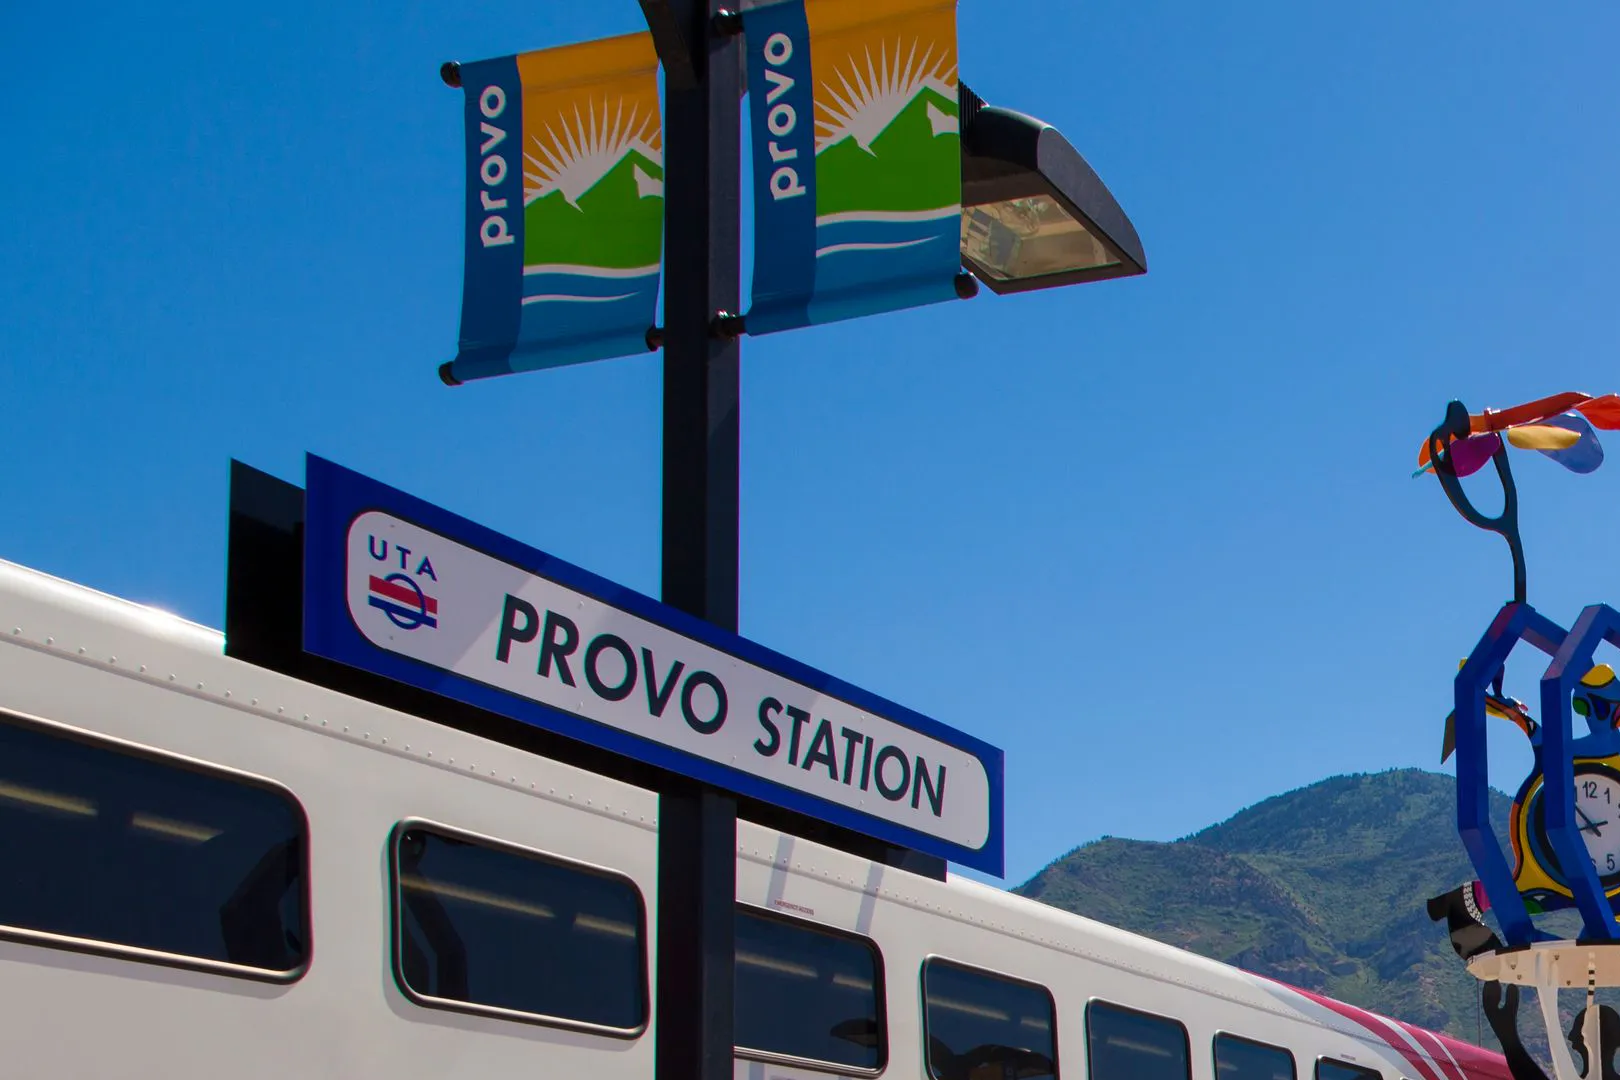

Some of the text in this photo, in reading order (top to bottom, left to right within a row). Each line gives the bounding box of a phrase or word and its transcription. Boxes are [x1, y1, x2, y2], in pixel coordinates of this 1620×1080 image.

[764, 32, 806, 200] provo
[480, 85, 515, 248] provo
[368, 534, 437, 582] UTA
[496, 593, 946, 818] PROVO STATION
[1582, 781, 1598, 798] 12
[1603, 787, 1610, 804] 1
[1606, 853, 1615, 871] 5
